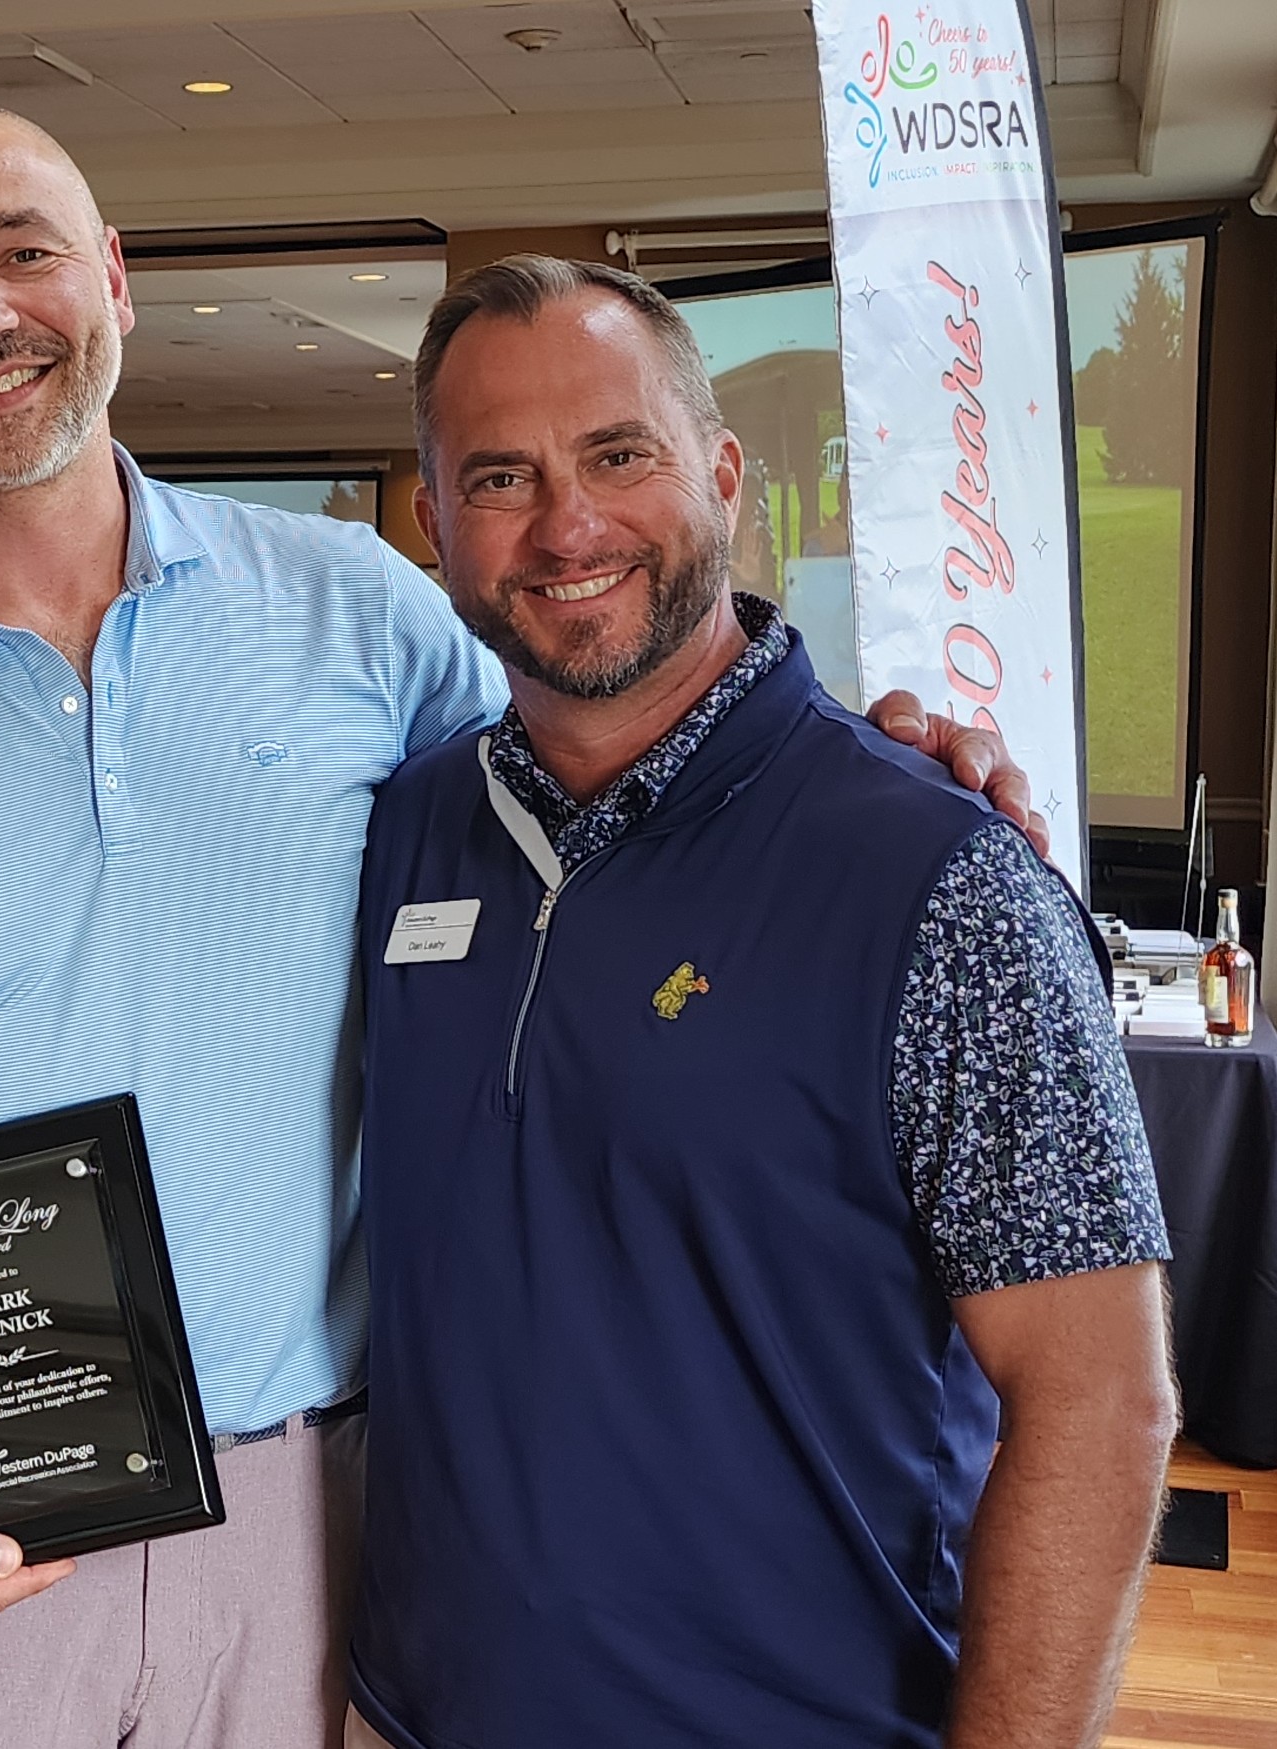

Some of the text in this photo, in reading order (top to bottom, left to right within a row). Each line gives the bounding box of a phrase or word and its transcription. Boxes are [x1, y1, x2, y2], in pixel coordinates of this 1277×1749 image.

[928, 18, 990, 46] Cheers to
[948, 48, 1017, 79] 50 years!
[892, 100, 1029, 154] WDSRA
[927, 261, 1015, 602] Years!
[9, 1267, 19, 1277] to
[2, 1380, 13, 1392] of
[14, 1378, 36, 1391] your
[37, 1366, 85, 1384] dedication
[85, 1363, 97, 1373] to
[17, 1379, 78, 1404] philanthropic
[79, 1373, 112, 1388] efforts,
[32, 1402, 43, 1412] to
[44, 1395, 75, 1408] inspire
[43, 1443, 96, 1465] DuPage
[56, 1460, 99, 1475] Association
